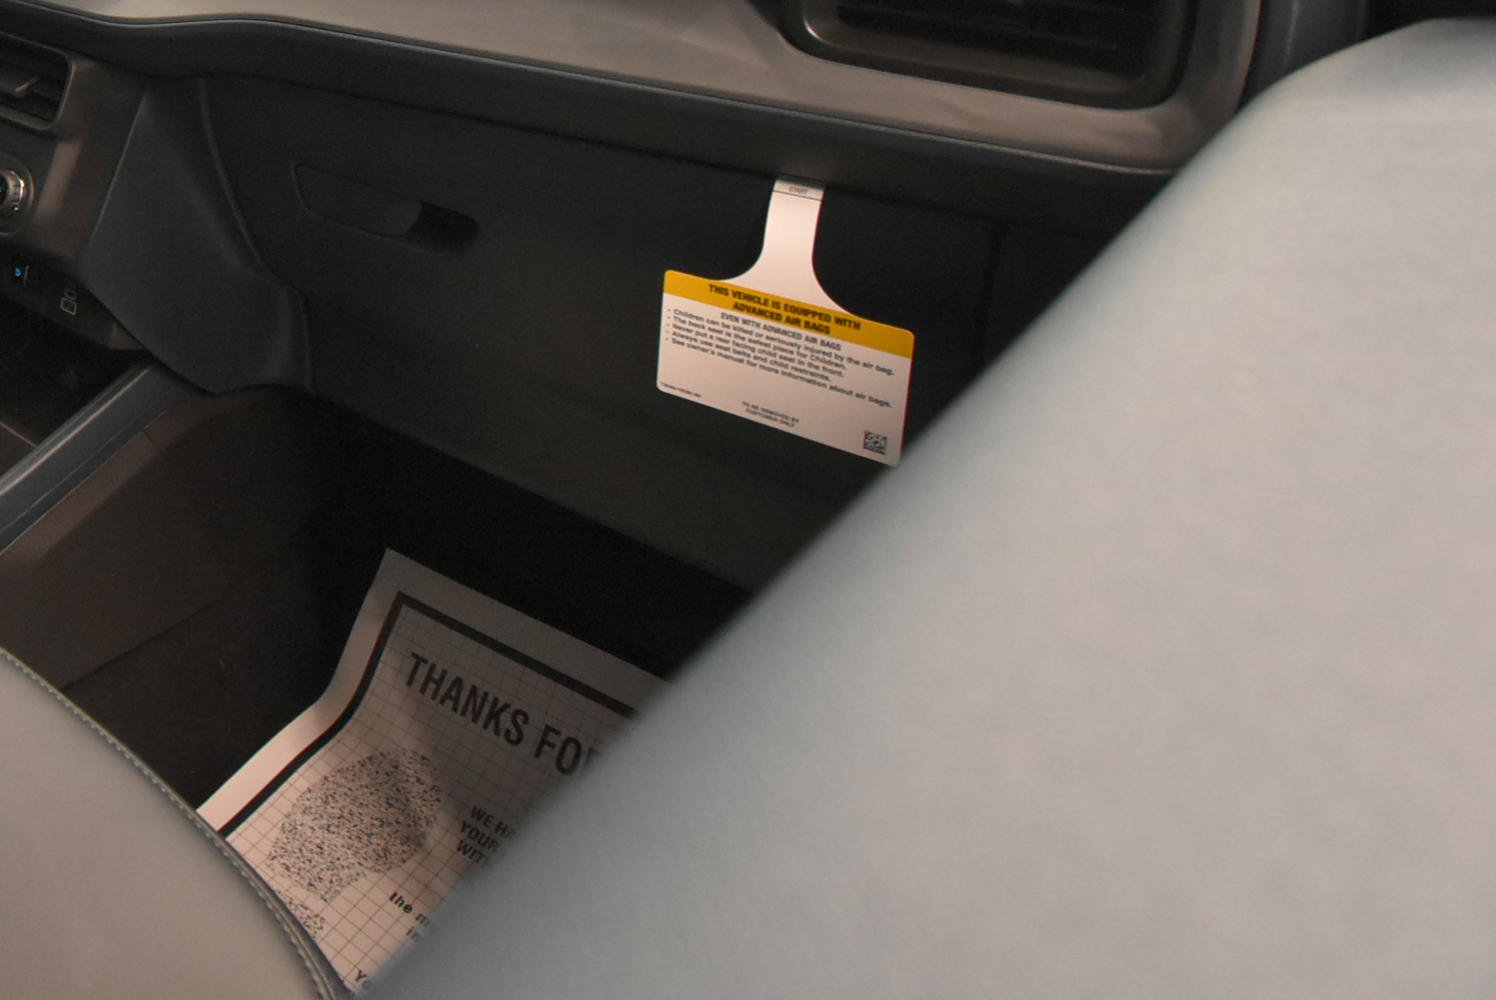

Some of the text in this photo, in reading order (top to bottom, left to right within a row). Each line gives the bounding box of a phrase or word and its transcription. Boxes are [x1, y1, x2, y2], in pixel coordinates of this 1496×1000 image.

[709, 285, 861, 331] THIS VEHICLE IS EQUIPPED WITH
[733, 303, 831, 335] ADVANCED AIR BAGS
[673, 324, 693, 335] Never
[696, 331, 707, 339] put
[716, 336, 730, 345] rear
[732, 341, 756, 352] facing
[758, 348, 777, 358] child
[779, 354, 795, 364] seat
[807, 362, 820, 371] the
[673, 331, 697, 343] Always
[700, 339, 713, 348] use
[716, 344, 730, 353] seat
[732, 348, 751, 359] belts
[753, 354, 768, 364] and
[770, 359, 789, 370] child
[674, 317, 687, 325] The
[688, 321, 705, 330] back
[708, 326, 723, 335] seat
[734, 333, 746, 342] the
[748, 337, 771, 349] safest
[773, 344, 794, 355] place
[797, 351, 808, 359] for
[674, 309, 704, 322] Children
[706, 318, 719, 327] can
[733, 326, 753, 336] killed
[765, 335, 801, 349] seriously
[804, 345, 833, 358] injured
[834, 354, 844, 362] by
[847, 357, 860, 366] the
[863, 362, 873, 370] air
[721, 313, 841, 351] EVEN WITH ADVANCED AIR BAGS
[406, 652, 529, 745] THANKS
[471, 805, 494, 828] WE
[390, 891, 413, 914] the
